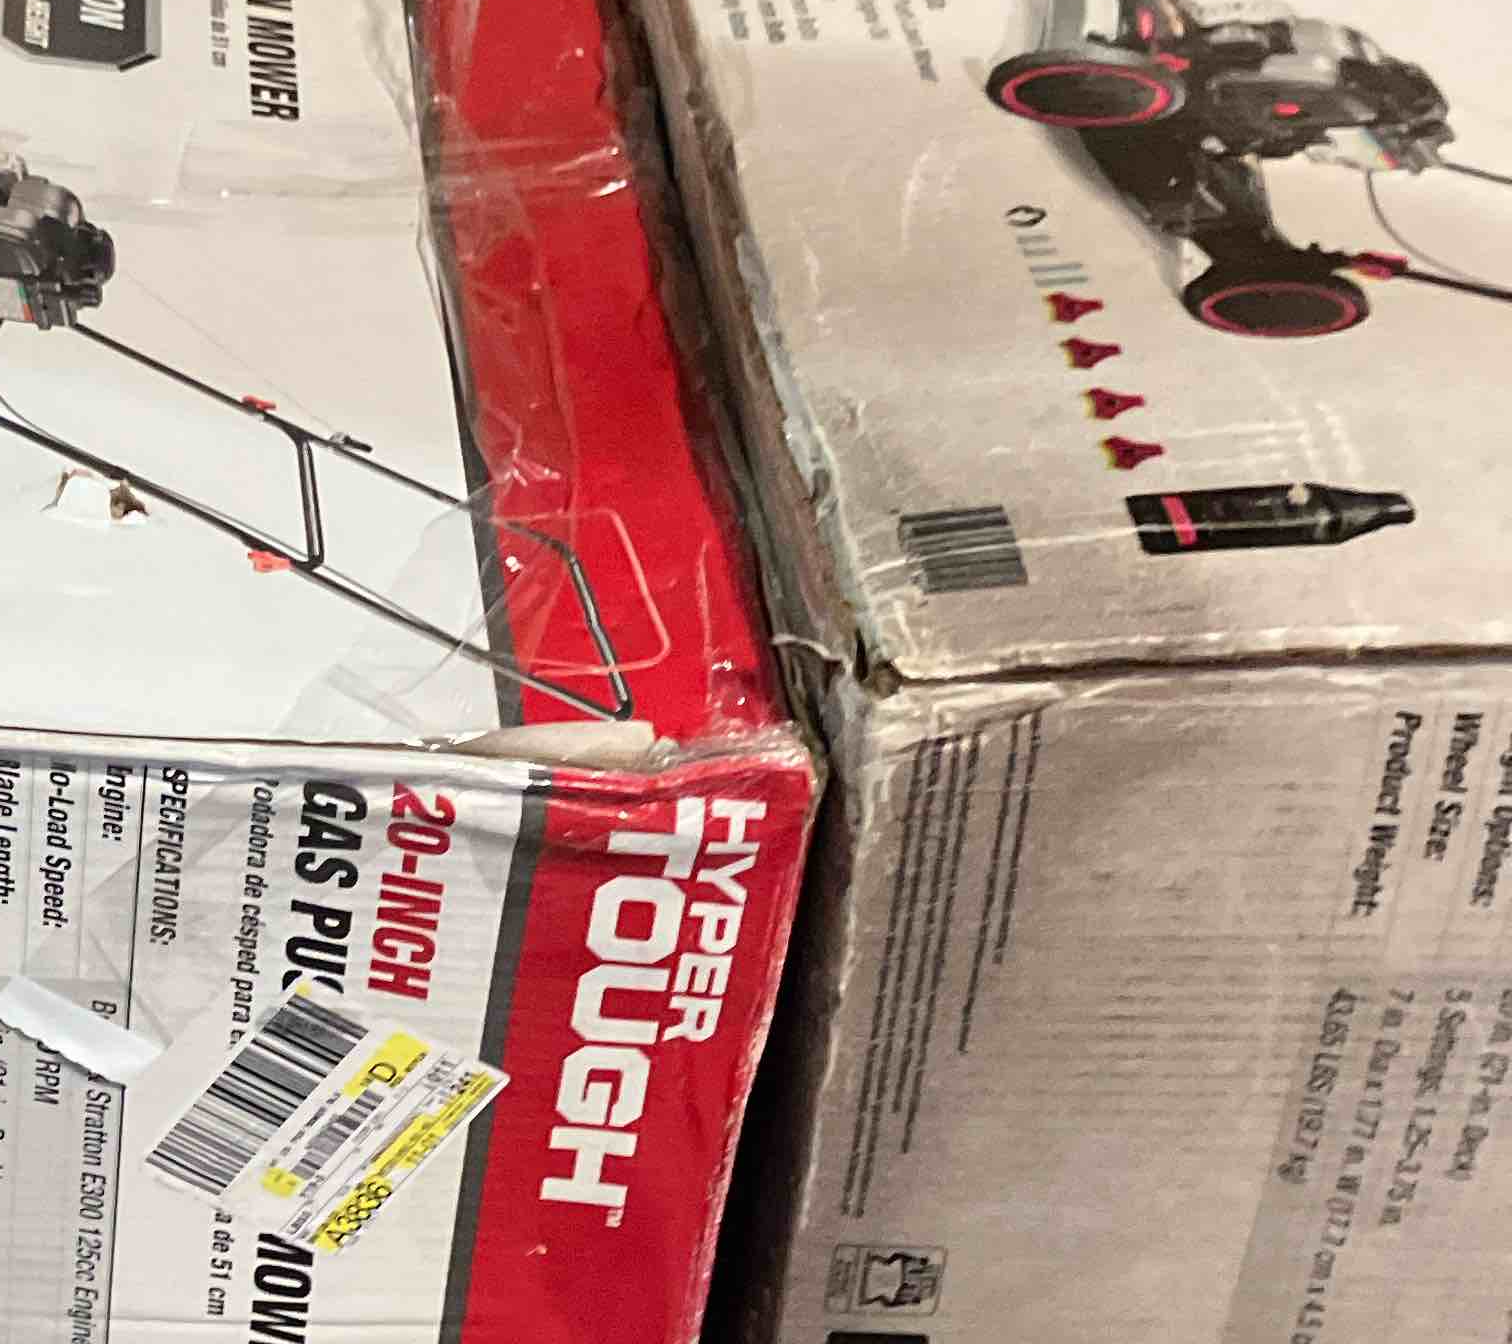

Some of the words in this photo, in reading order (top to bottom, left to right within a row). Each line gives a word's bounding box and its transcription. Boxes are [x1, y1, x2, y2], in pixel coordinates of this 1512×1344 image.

[248, 16, 300, 121] MOWER
[1375, 710, 1423, 816] Product
[1440, 711, 1485, 793] Wheel
[98, 764, 134, 841] Engine:
[295, 780, 368, 889] GAS
[39, 854, 72, 928] Speed:
[149, 766, 189, 946] SPECIFICATIONS:
[244, 874, 268, 899] de
[368, 777, 456, 998] 20-INCH
[1350, 824, 1400, 918] Weight:
[232, 904, 266, 974] césped
[662, 797, 767, 1043] HYPER
[229, 977, 248, 1024] para
[33, 1059, 61, 1105] RPM
[1306, 1052, 1341, 1094] LBS
[82, 1089, 112, 1167] Stratton
[79, 1173, 107, 1220] E300
[75, 1228, 103, 1282] 125cc
[210, 1258, 233, 1281] 51
[211, 1230, 235, 1253] de
[207, 1288, 227, 1317] cm
